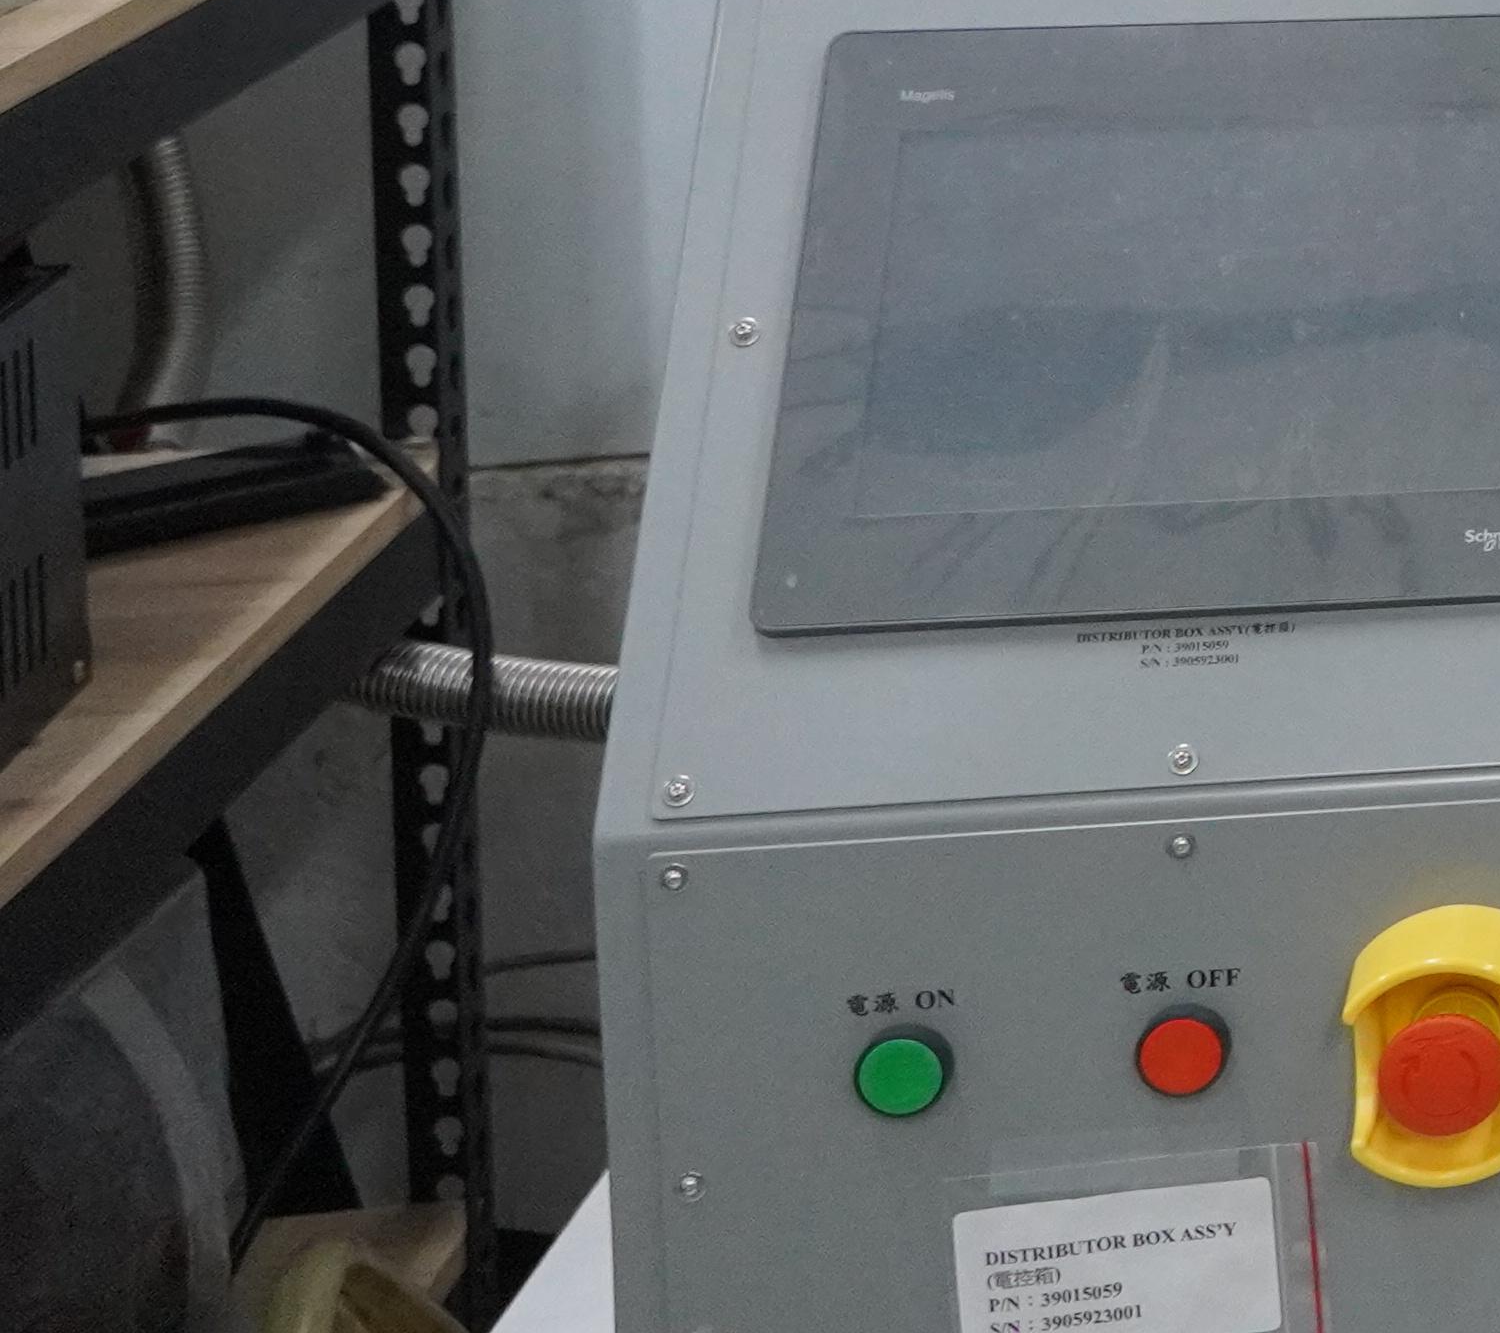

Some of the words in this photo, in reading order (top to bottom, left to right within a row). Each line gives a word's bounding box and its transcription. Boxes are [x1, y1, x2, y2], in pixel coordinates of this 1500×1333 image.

[1076, 627, 1172, 644] DISTRIBUTOR
[1175, 626, 1203, 638] BOX
[1119, 970, 1172, 996] 電源
[1186, 966, 1242, 989] OFF
[845, 991, 901, 1017] 電源
[914, 988, 957, 1011] ON
[985, 1234, 1127, 1267] DISTRIBUTOR
[1132, 1227, 1177, 1248] BOX
[989, 1295, 1021, 1314] P/N
[1039, 1281, 1124, 1309] 39015059
[1041, 1303, 1143, 1332] 3905923001
